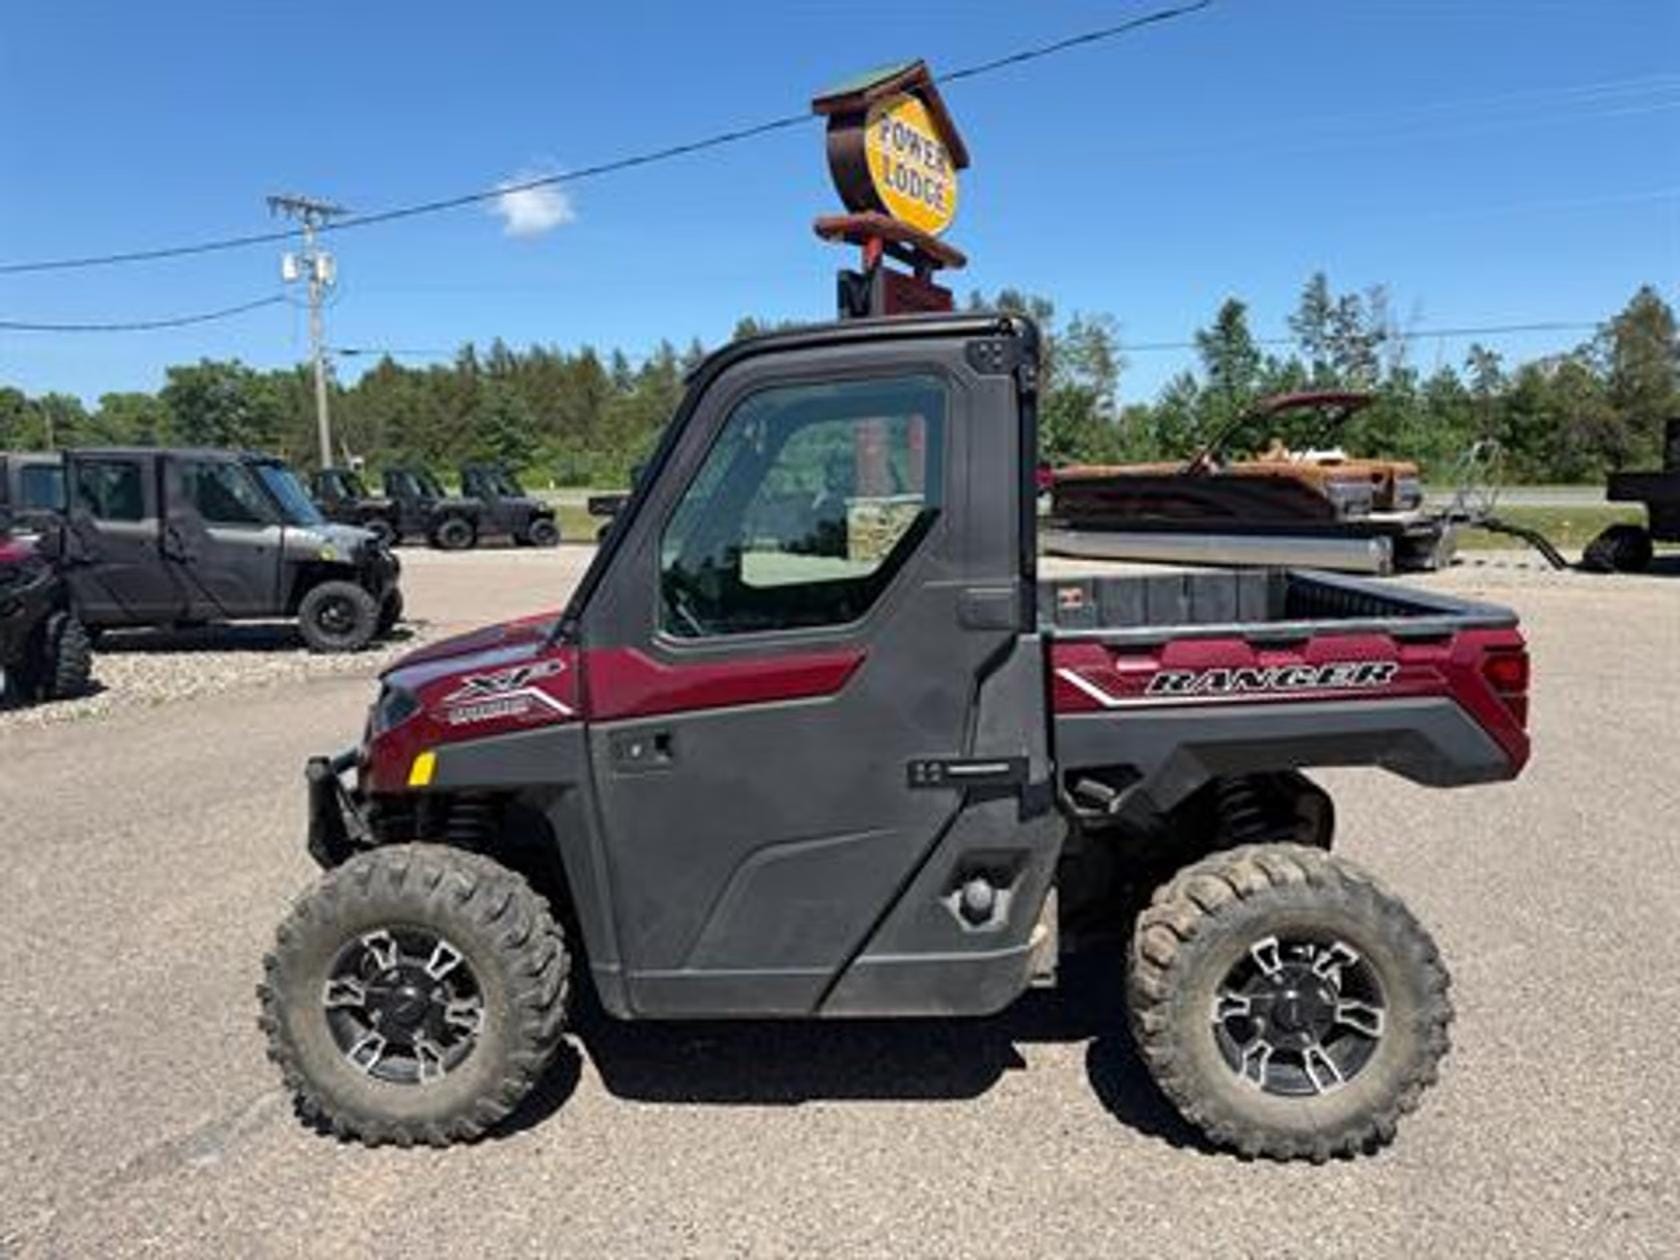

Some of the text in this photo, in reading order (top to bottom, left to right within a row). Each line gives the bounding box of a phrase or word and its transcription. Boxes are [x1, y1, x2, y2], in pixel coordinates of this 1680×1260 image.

[880, 112, 947, 172] POWER
[882, 155, 946, 211] LODGE
[1146, 662, 1400, 695] RANGER
